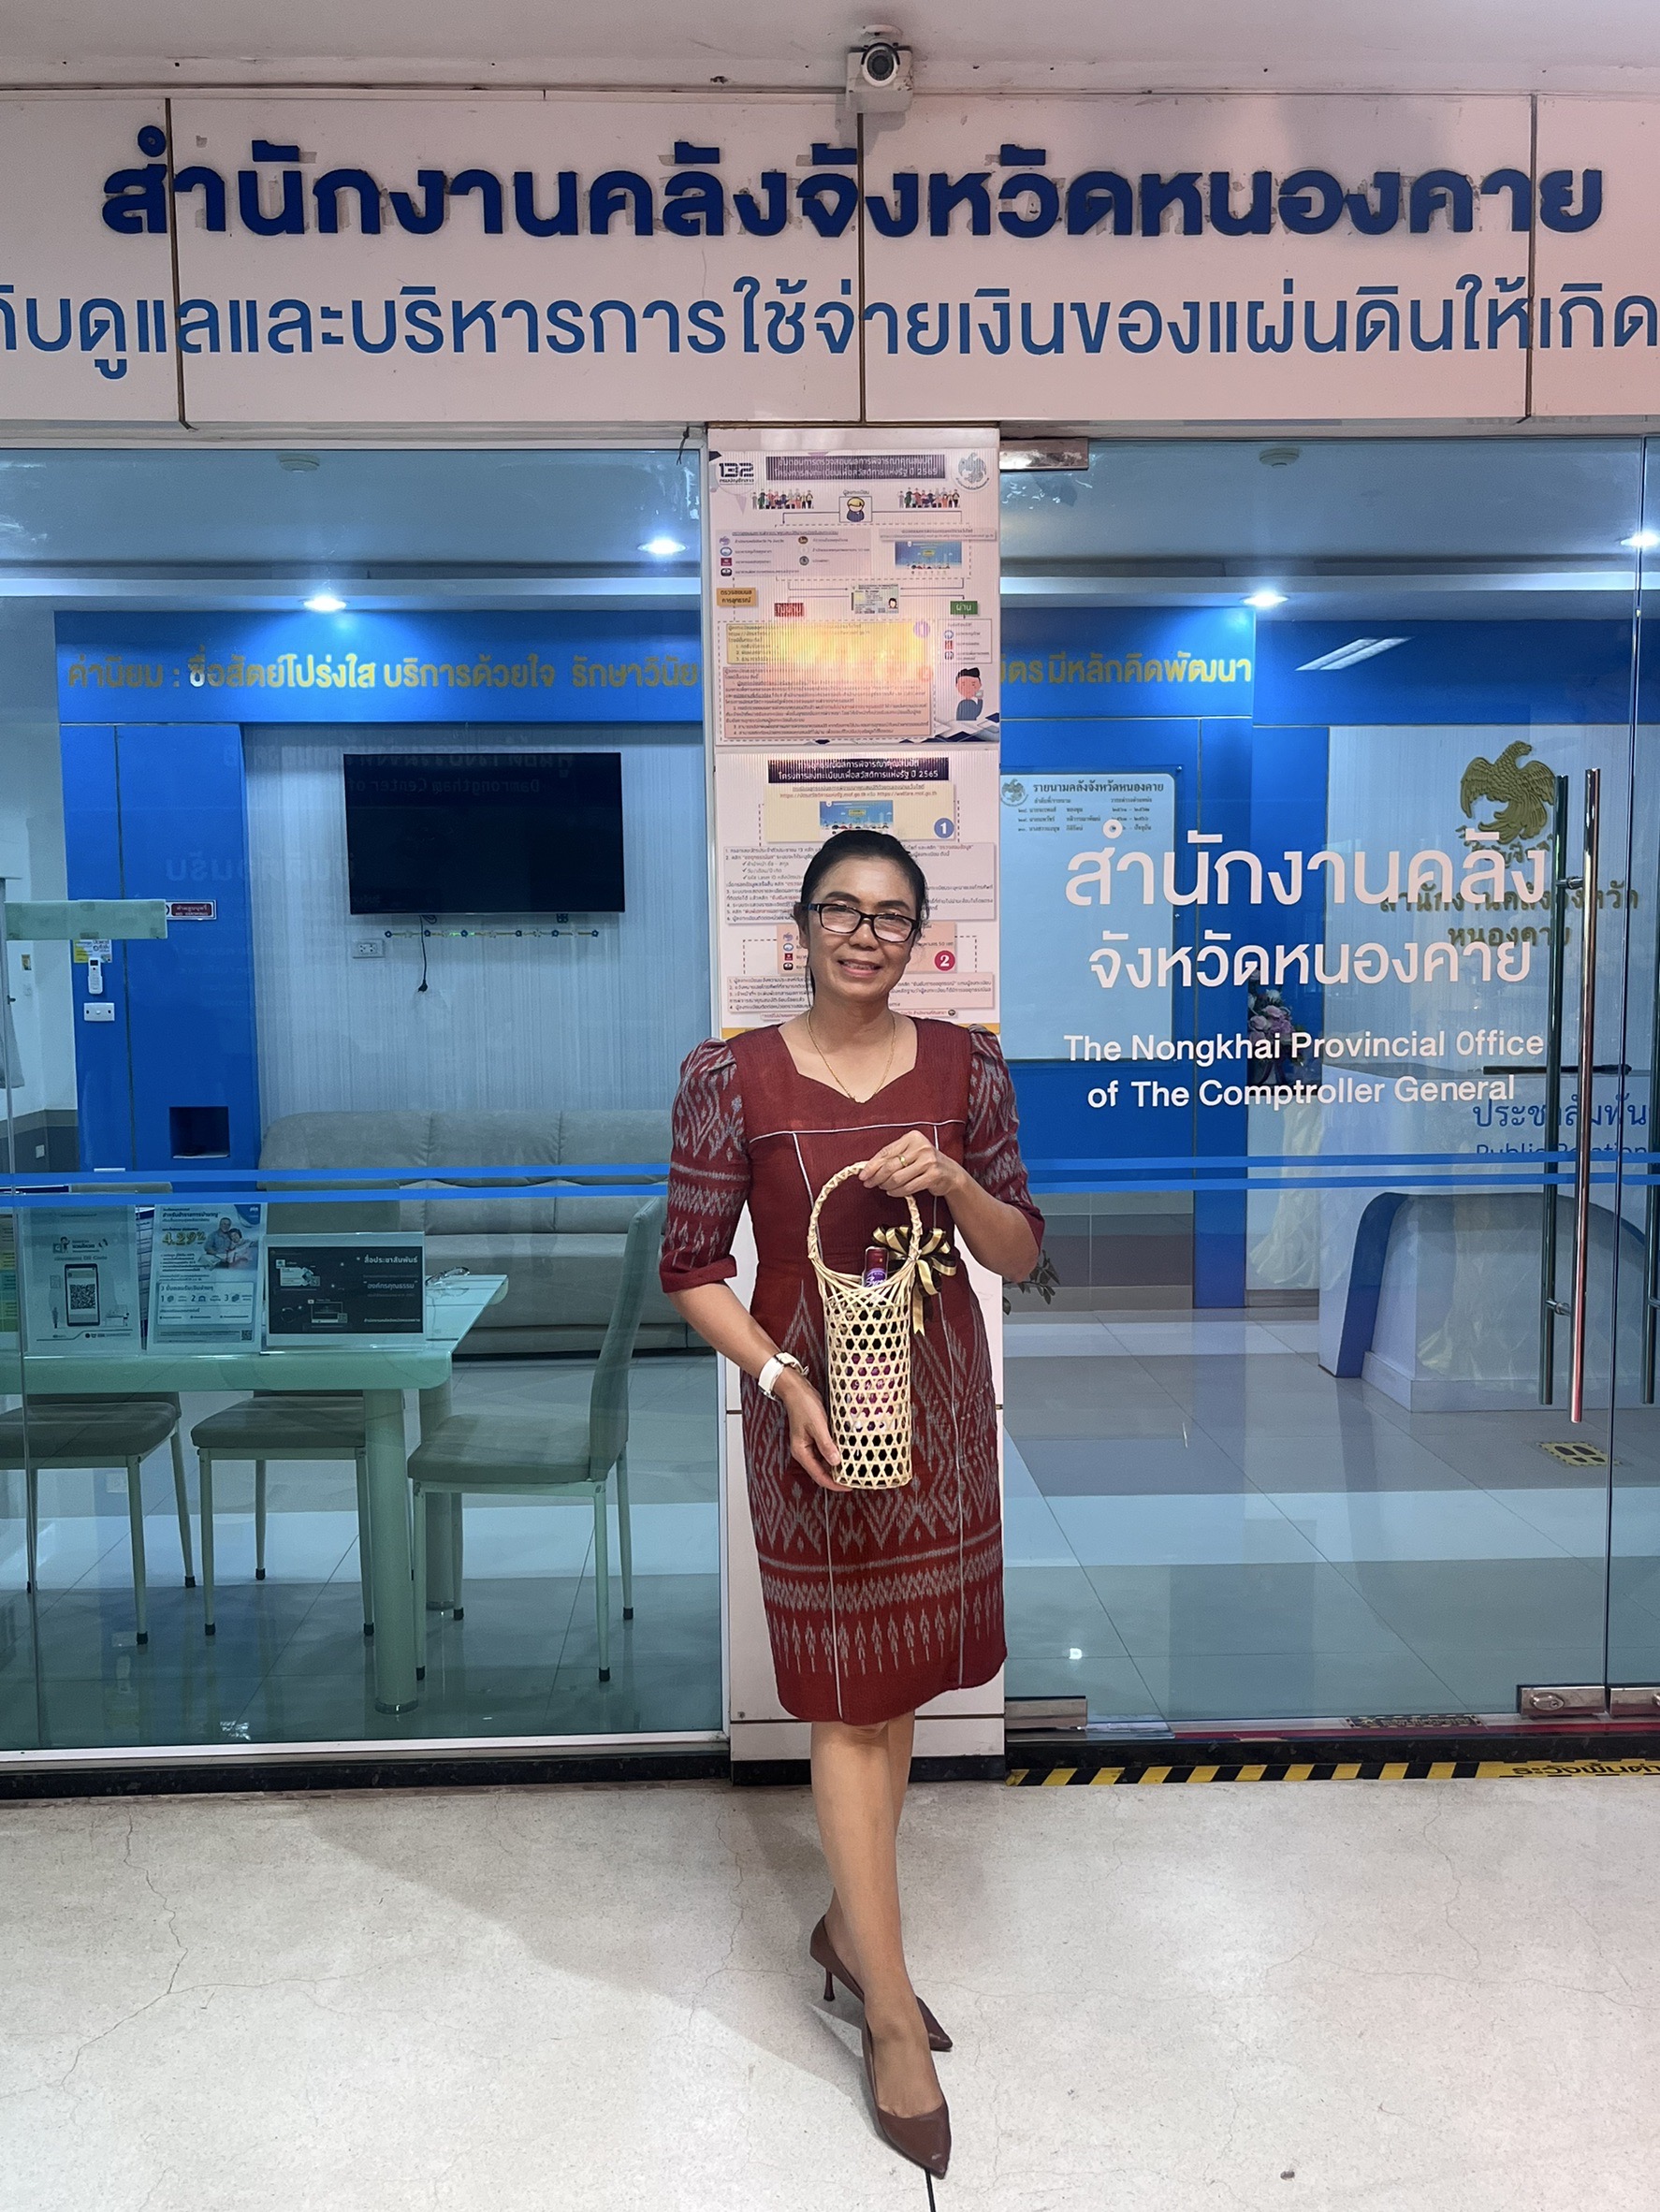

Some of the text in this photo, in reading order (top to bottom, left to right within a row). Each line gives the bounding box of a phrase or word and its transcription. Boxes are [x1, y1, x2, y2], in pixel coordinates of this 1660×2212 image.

[102, 127, 1604, 237] สำนักงานคลังจังหวัดหนองคาย
[719, 462, 754, 477] 132
[955, 603, 972, 611] ผ่าน
[67, 653, 163, 688] ค่านิยม
[384, 653, 555, 688] บริการด้วยใจ
[1048, 651, 1251, 684] มีหลักคิดพัฒนา
[919, 769, 939, 778] 2565
[1032, 779, 1164, 793] รายนามคลังจังหวัดหนองคาย
[939, 823, 947, 834] 1
[1065, 820, 1546, 907] สำนักงานคลัง
[939, 954, 950, 967] 2
[1088, 929, 1531, 989] จังหวัดหนองคาย
[1064, 1034, 1122, 1061] The
[1131, 1032, 1280, 1067] Nongkhai
[1291, 1030, 1445, 1058] Provincial
[1087, 1074, 1515, 1112] of The Comptroller General
